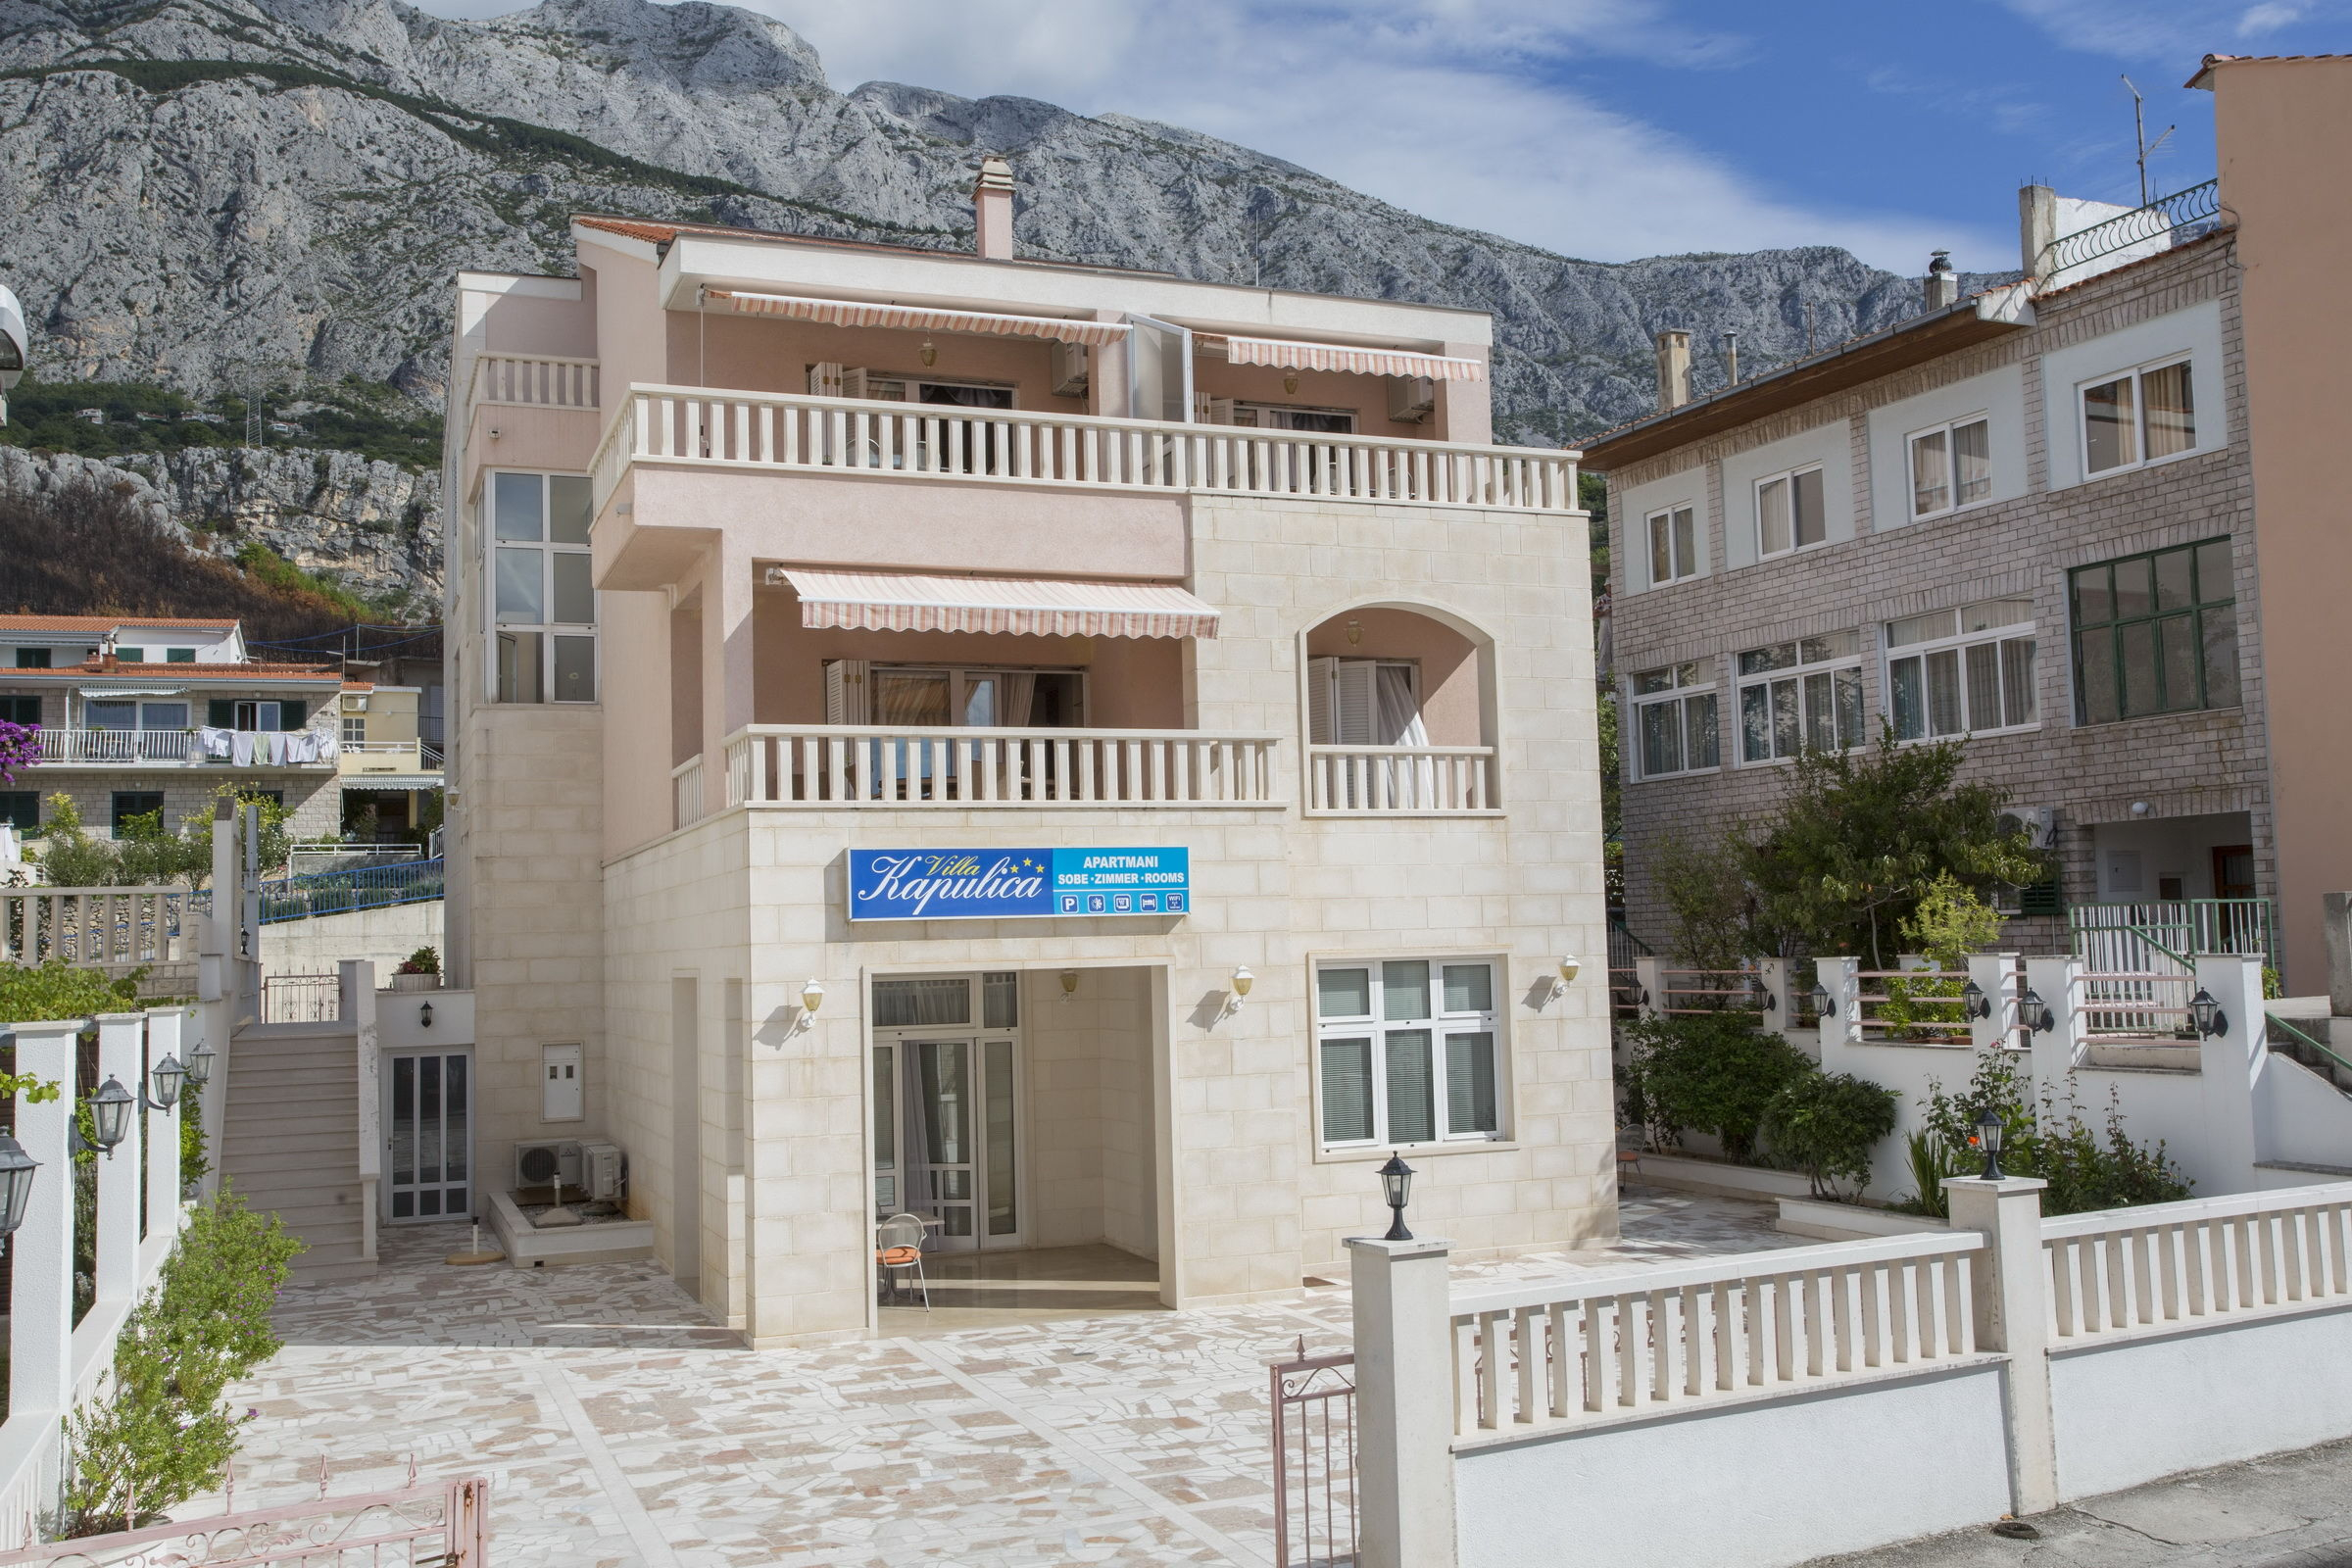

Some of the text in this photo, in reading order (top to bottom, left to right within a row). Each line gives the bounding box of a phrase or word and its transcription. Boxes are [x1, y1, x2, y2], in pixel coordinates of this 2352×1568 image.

[924, 855, 982, 877] Villa
[1083, 856, 1158, 869] APARTMANI
[858, 856, 1043, 915] Kapulica
[1057, 873, 1089, 885] SOBE
[1064, 898, 1075, 910] P
